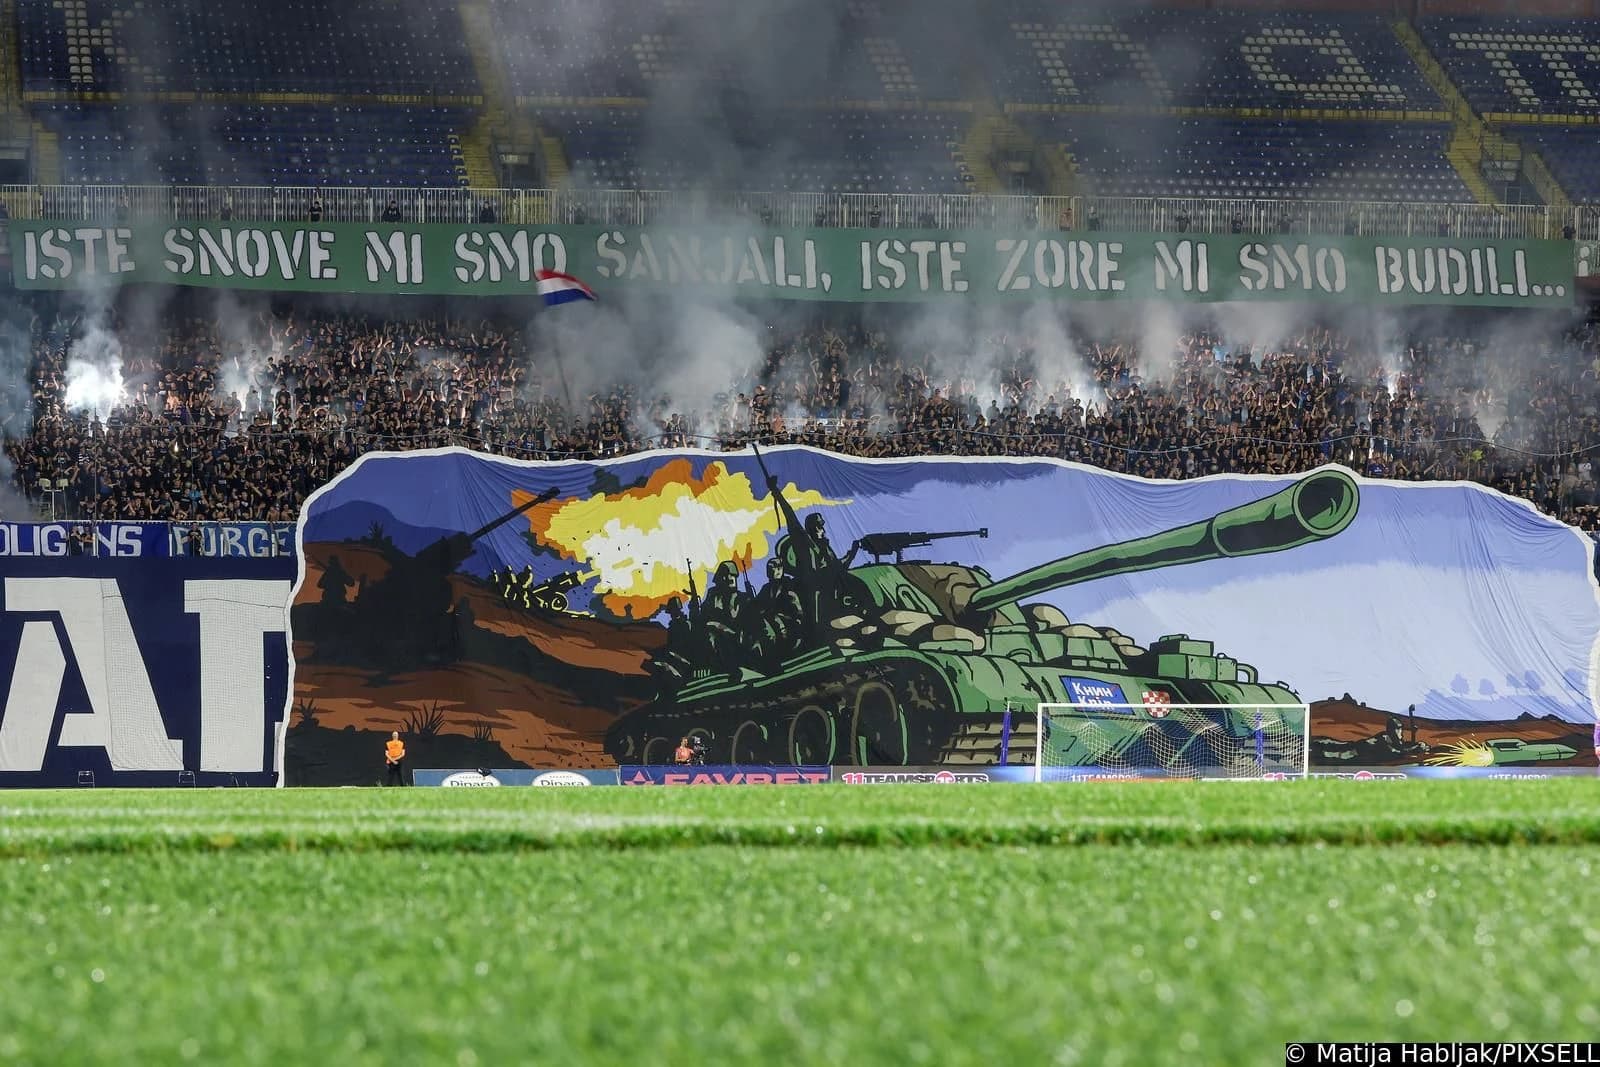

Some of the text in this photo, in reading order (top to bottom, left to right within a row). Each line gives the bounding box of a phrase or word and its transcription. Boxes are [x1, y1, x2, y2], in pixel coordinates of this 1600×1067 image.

[24, 228, 1565, 297] ISTE SNOVE MI SMO SANJALI, ISTE ZORE MI SMO BUDILI...
